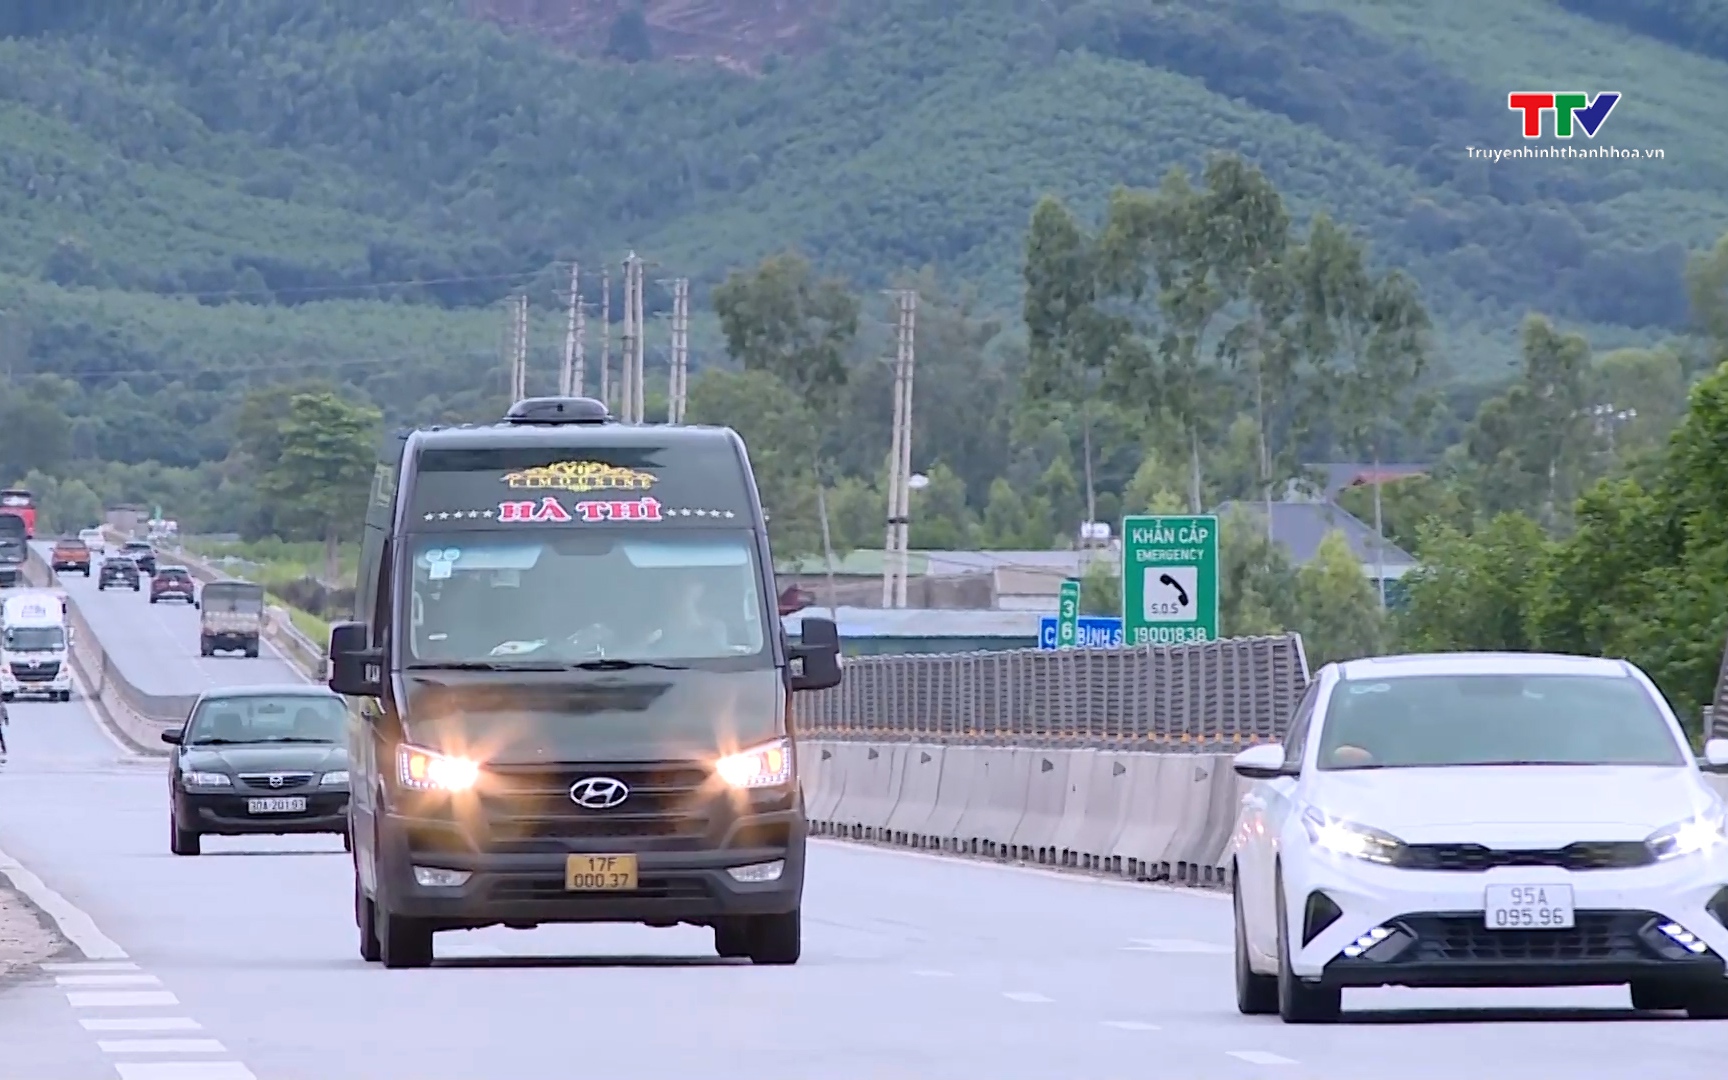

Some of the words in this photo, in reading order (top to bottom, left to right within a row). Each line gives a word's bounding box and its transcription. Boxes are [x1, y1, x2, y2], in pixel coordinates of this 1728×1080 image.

[509, 476, 652, 489] LIMOUSINE
[498, 497, 572, 522] HÀ
[576, 497, 663, 522] THÌ
[1132, 519, 1175, 544] KHẨN
[1178, 519, 1209, 544] CẤP
[1135, 549, 1205, 562] EMERGENCY
[1132, 627, 1207, 643] 19001838
[588, 857, 618, 872] 17F
[573, 872, 630, 889] 000.37
[1510, 887, 1549, 906] 95A
[1496, 908, 1565, 927] 095.96
